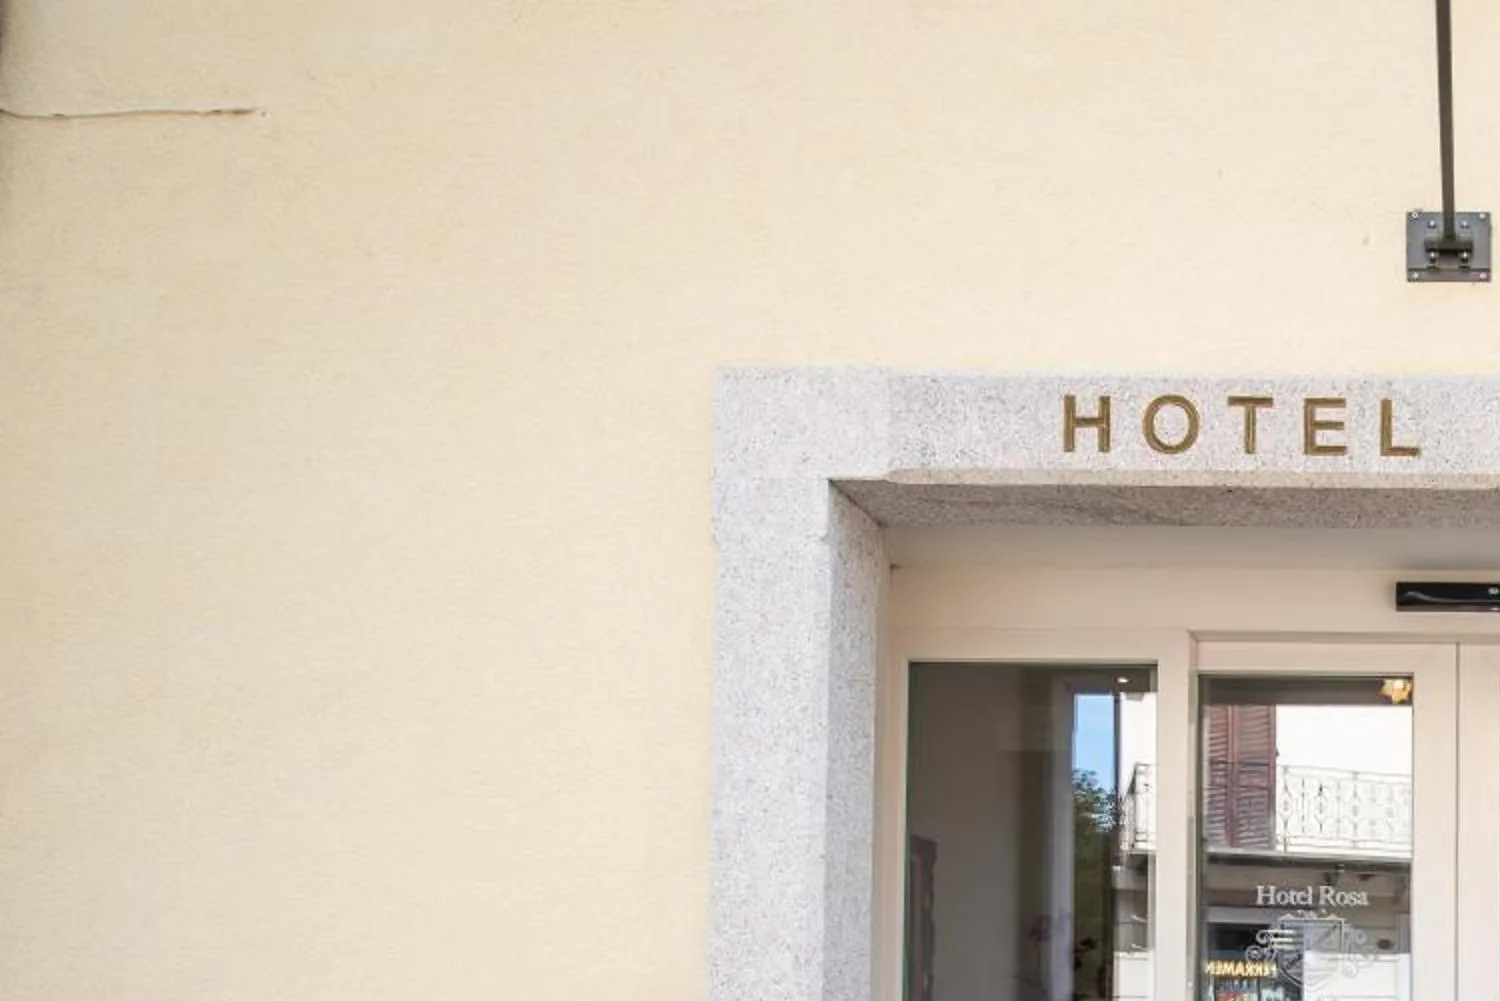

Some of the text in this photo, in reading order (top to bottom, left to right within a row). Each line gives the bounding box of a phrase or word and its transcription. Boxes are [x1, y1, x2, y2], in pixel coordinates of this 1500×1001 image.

[1062, 395, 1421, 457] HOTEL
[1256, 885, 1370, 906] Hotel Rosa
